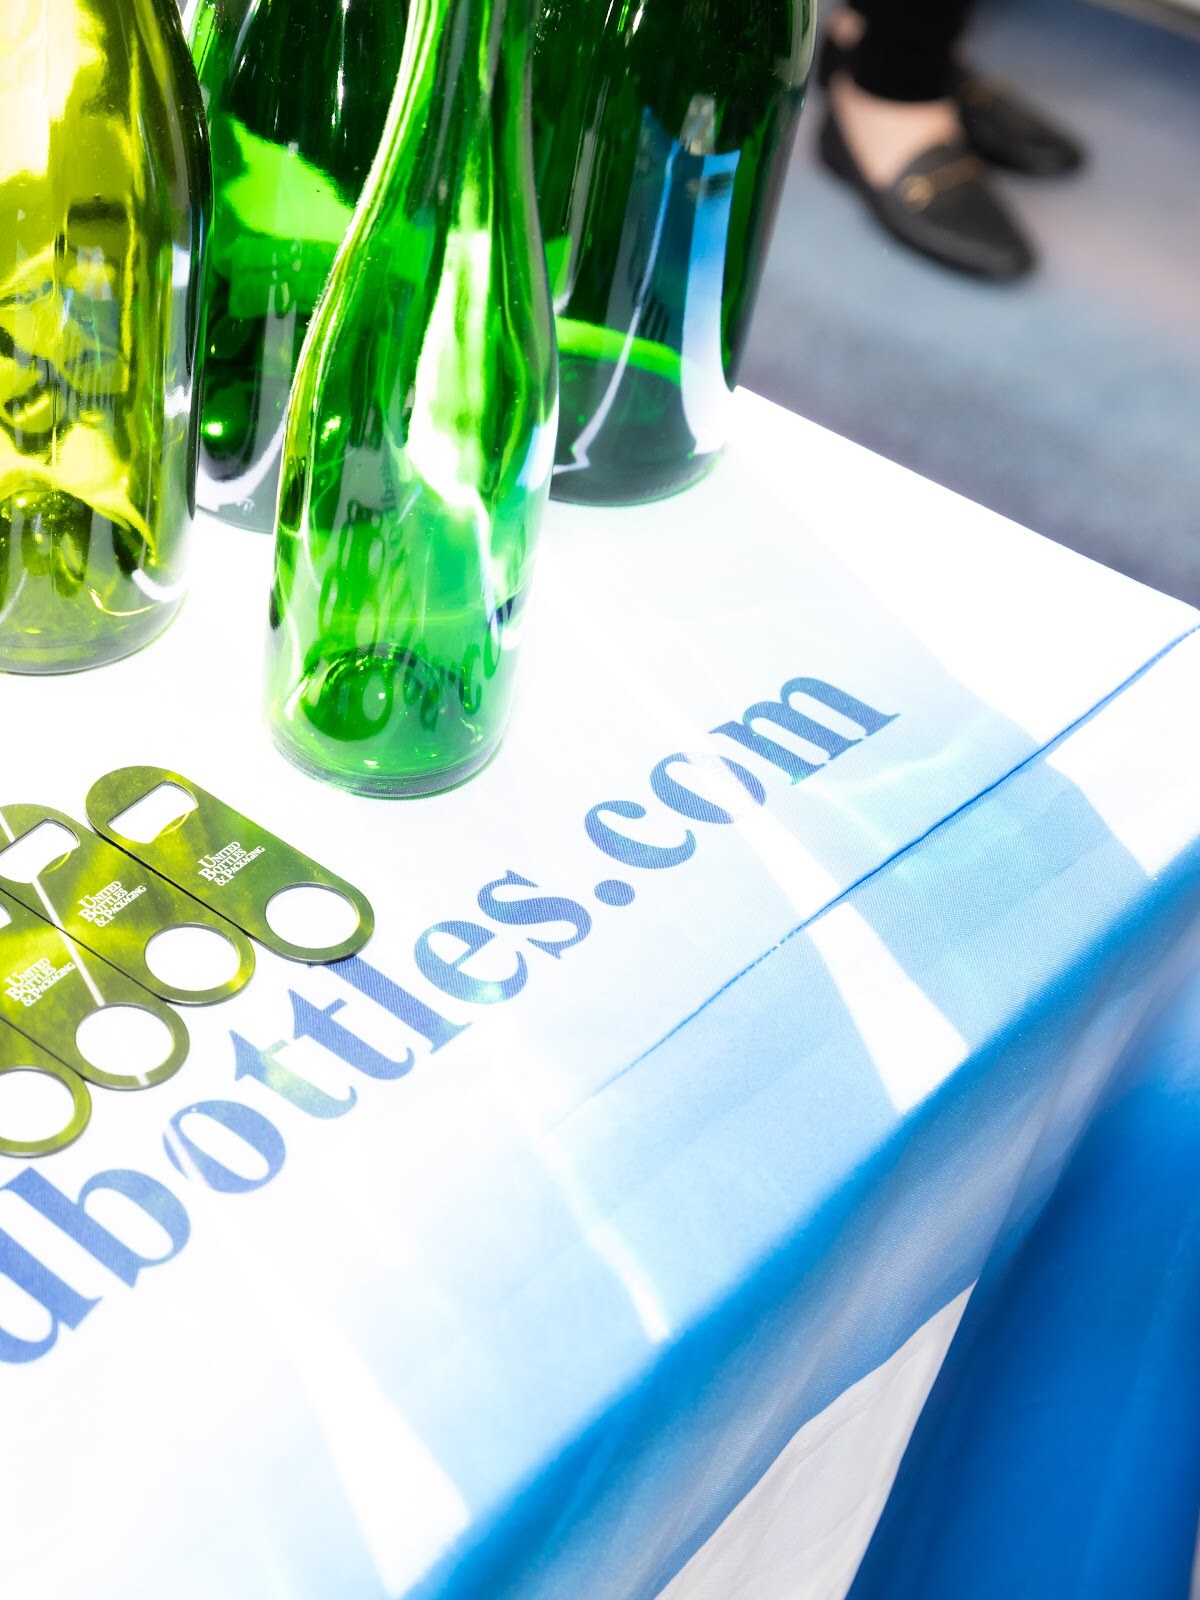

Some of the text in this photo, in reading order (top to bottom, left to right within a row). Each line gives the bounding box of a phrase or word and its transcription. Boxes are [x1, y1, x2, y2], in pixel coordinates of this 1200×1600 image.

[197, 841, 241, 869] UNITED
[198, 848, 247, 881] BOTTLES
[78, 881, 122, 909] UNITED
[78, 887, 128, 922] BOTTLES
[4, 965, 56, 1001] BOTTLES
[5, 957, 51, 987] UNITED
